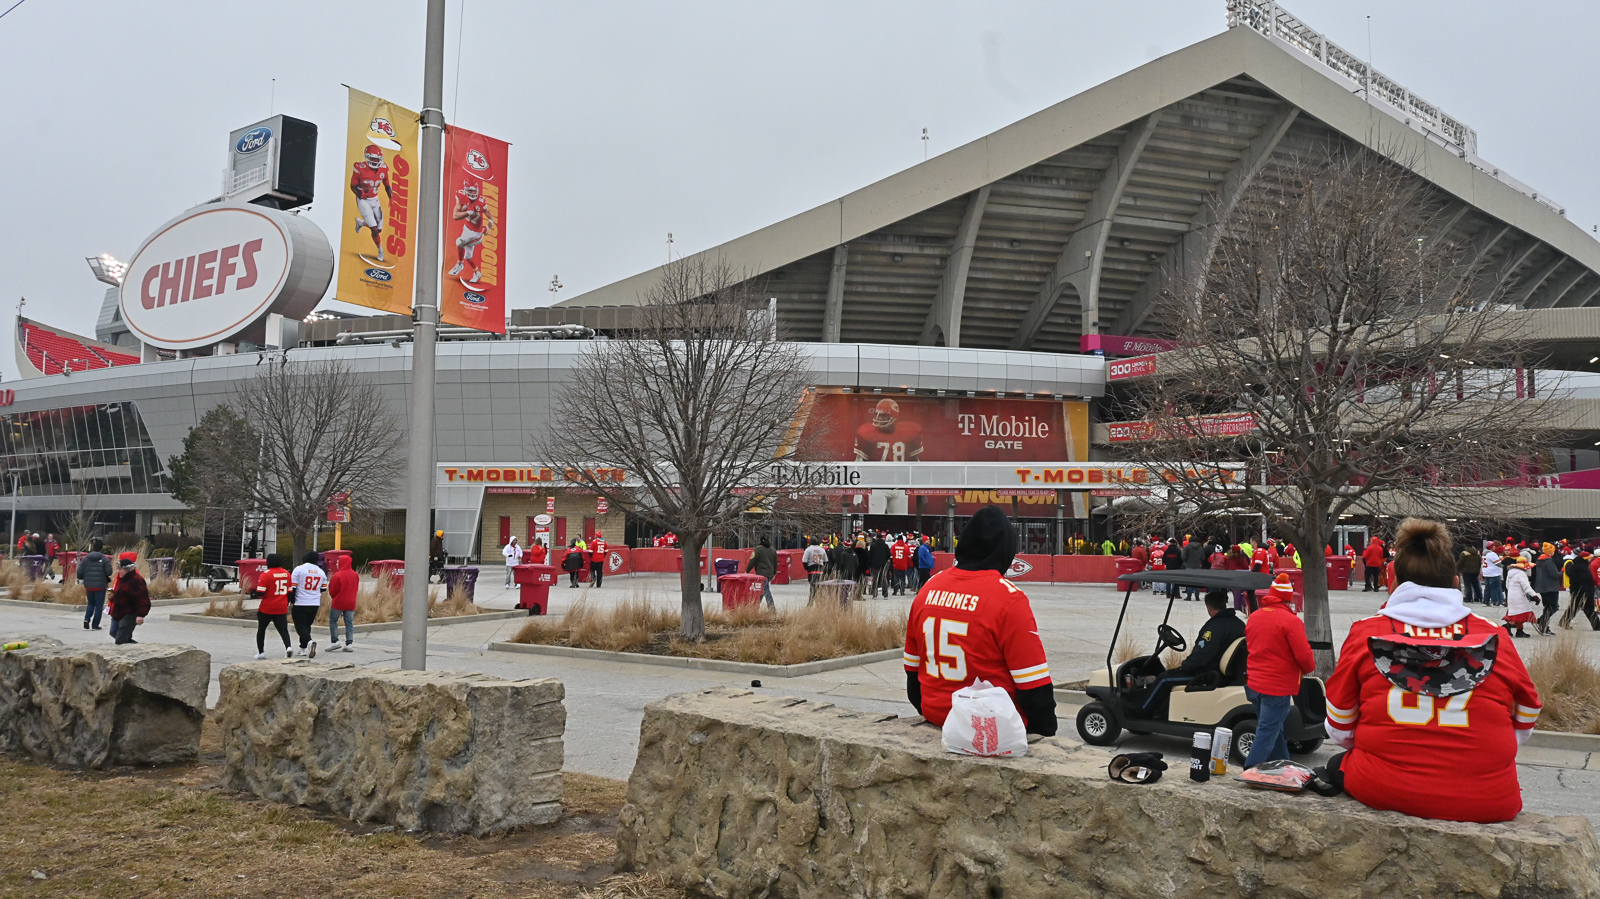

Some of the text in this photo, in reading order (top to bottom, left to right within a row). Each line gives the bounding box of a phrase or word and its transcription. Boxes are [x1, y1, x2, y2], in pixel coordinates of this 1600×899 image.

[241, 130, 266, 152] Ford
[386, 153, 411, 258] CHIEFS
[480, 181, 499, 287] KINGDOM
[140, 237, 263, 311] CHIEFS
[369, 269, 390, 281] Ford
[466, 291, 481, 303] Ford
[1110, 363, 1131, 376] 300
[978, 414, 1049, 439] Mobile
[876, 441, 906, 462] 78
[984, 440, 1023, 450] GATE
[444, 467, 626, 482] T-MOBILE GATE
[791, 464, 861, 487] Mobile
[1015, 467, 1150, 484] T-MOBILE
[953, 489, 1059, 505] INGOM
[596, 545, 605, 554] 15
[895, 549, 904, 559] 15
[1153, 557, 1163, 566] 32
[273, 579, 288, 596] 15
[304, 575, 321, 592] 87
[924, 589, 980, 612] MAHOMES
[922, 616, 969, 682] 15
